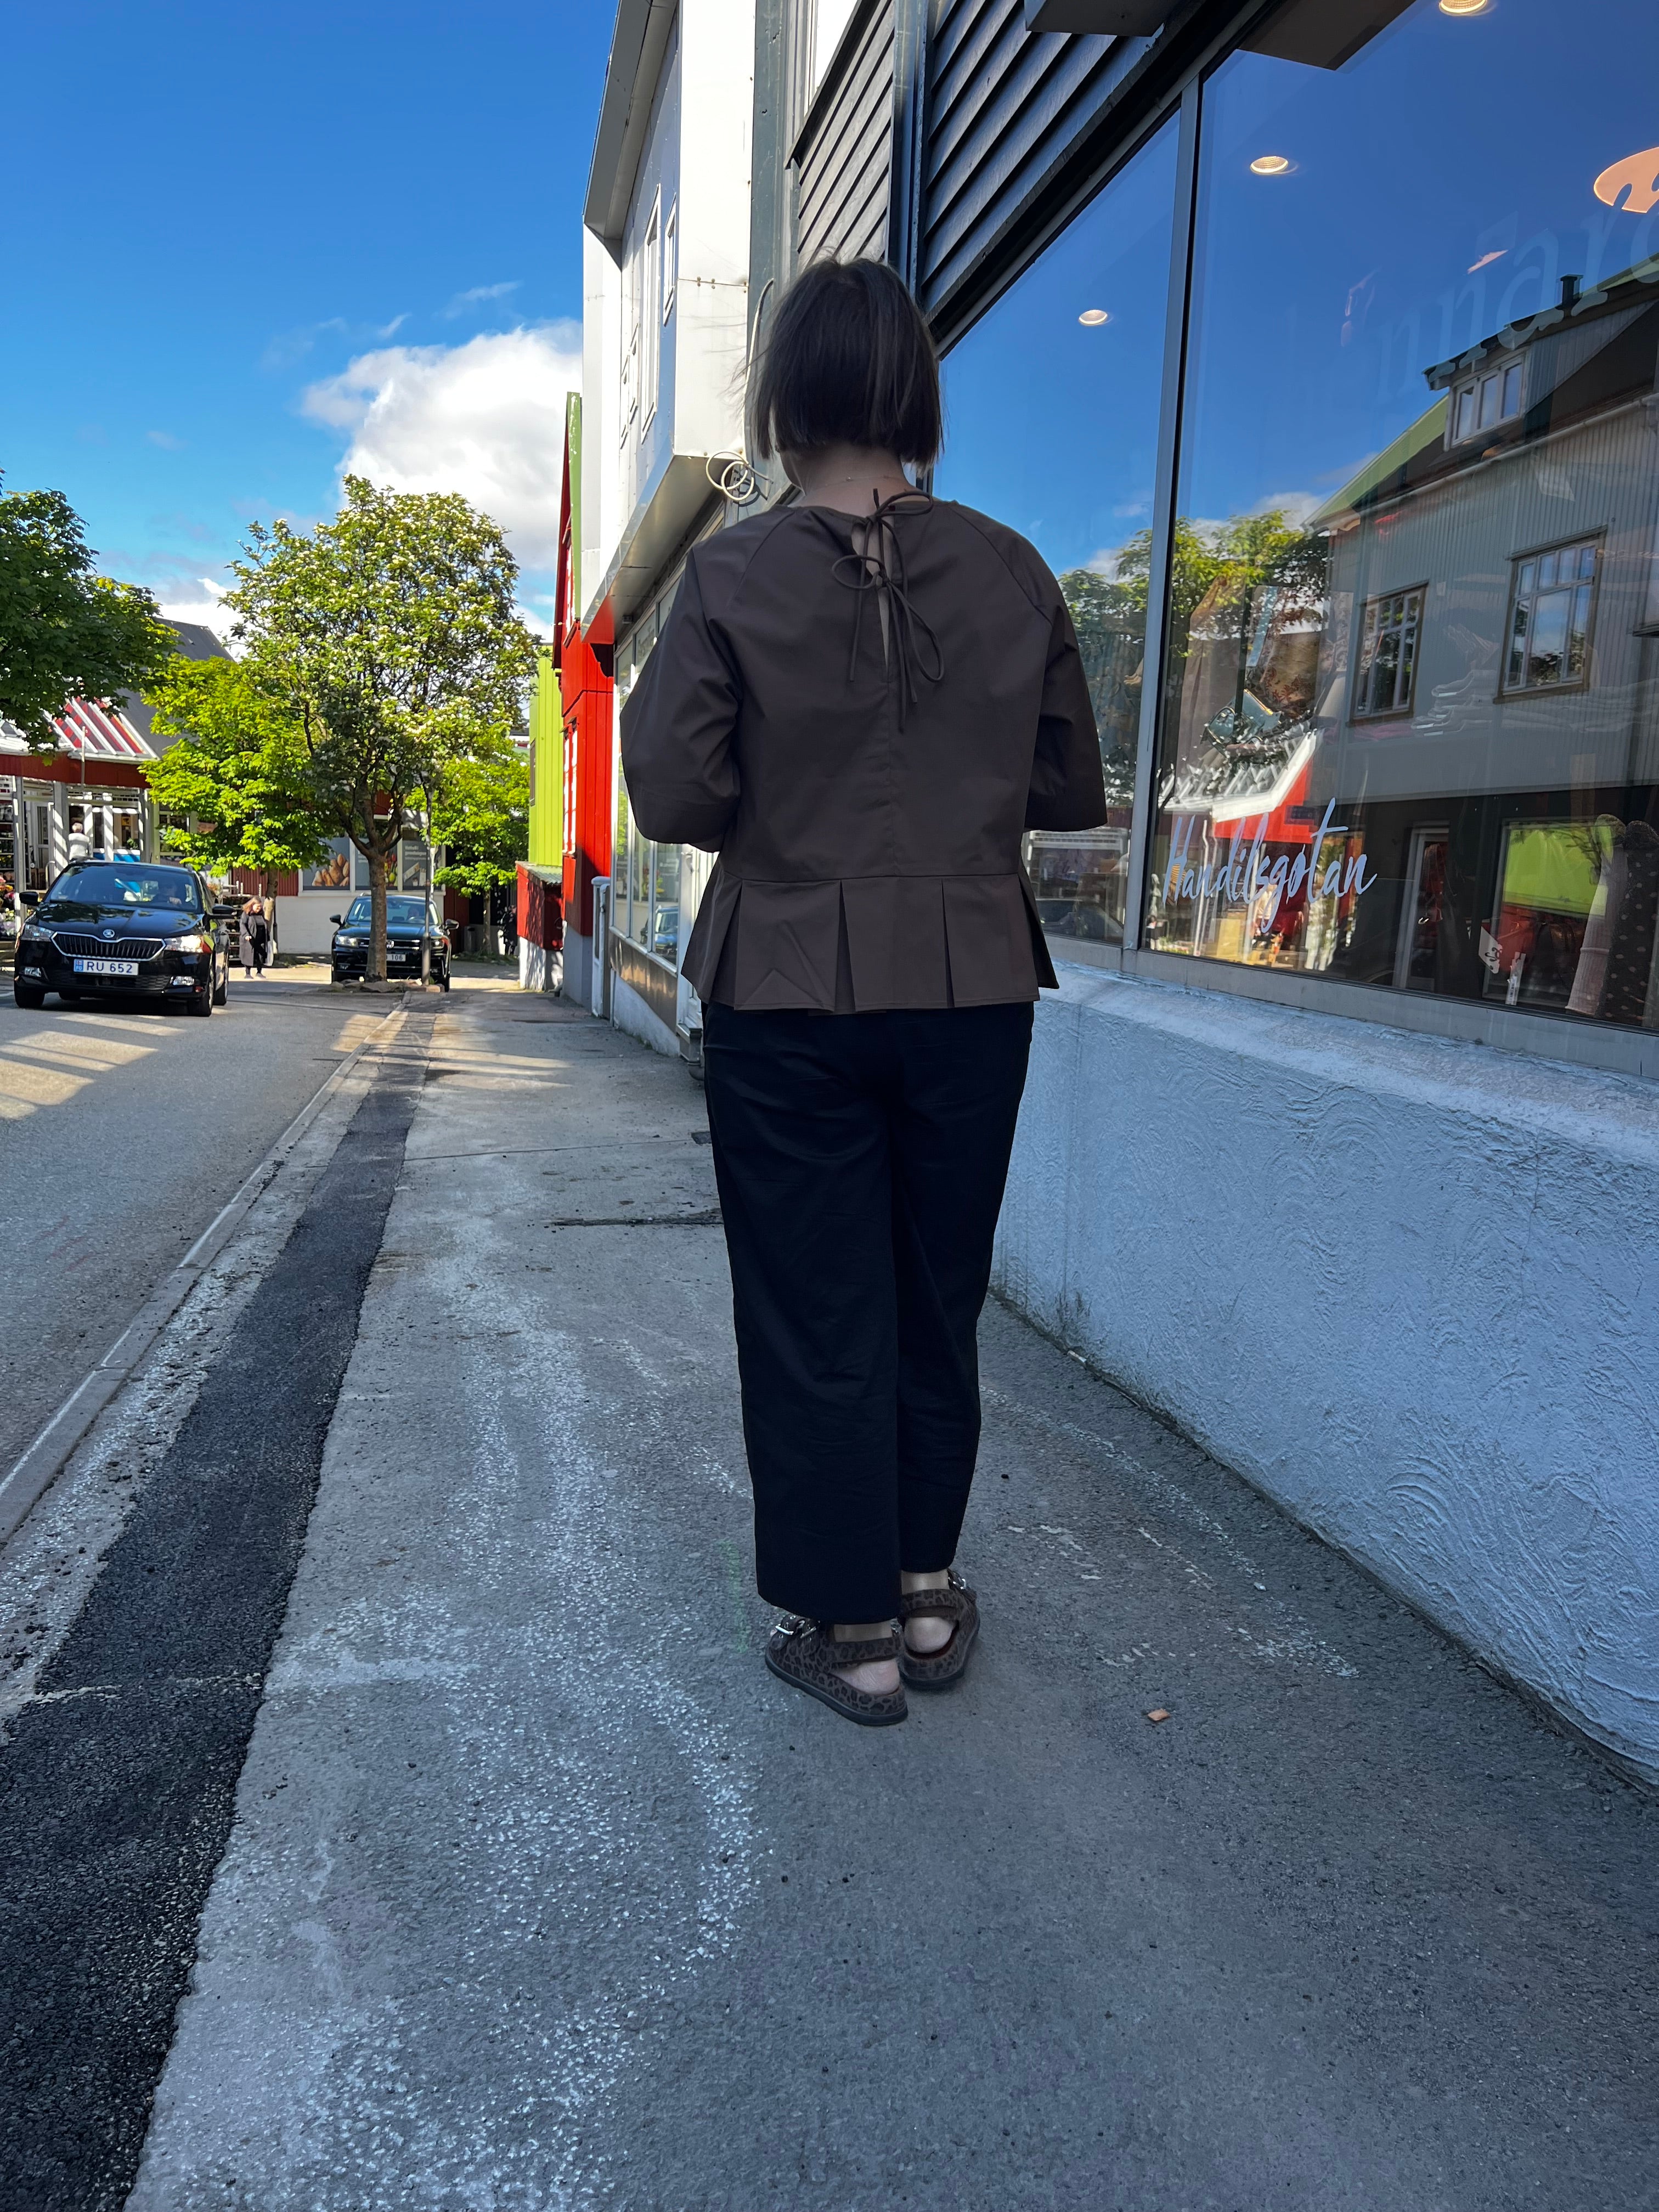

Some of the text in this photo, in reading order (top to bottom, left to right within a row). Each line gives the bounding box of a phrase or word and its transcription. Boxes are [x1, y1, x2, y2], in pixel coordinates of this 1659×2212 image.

[1163, 797, 1378, 933] Handilsgøtan
[87, 961, 132, 973] RU 652
